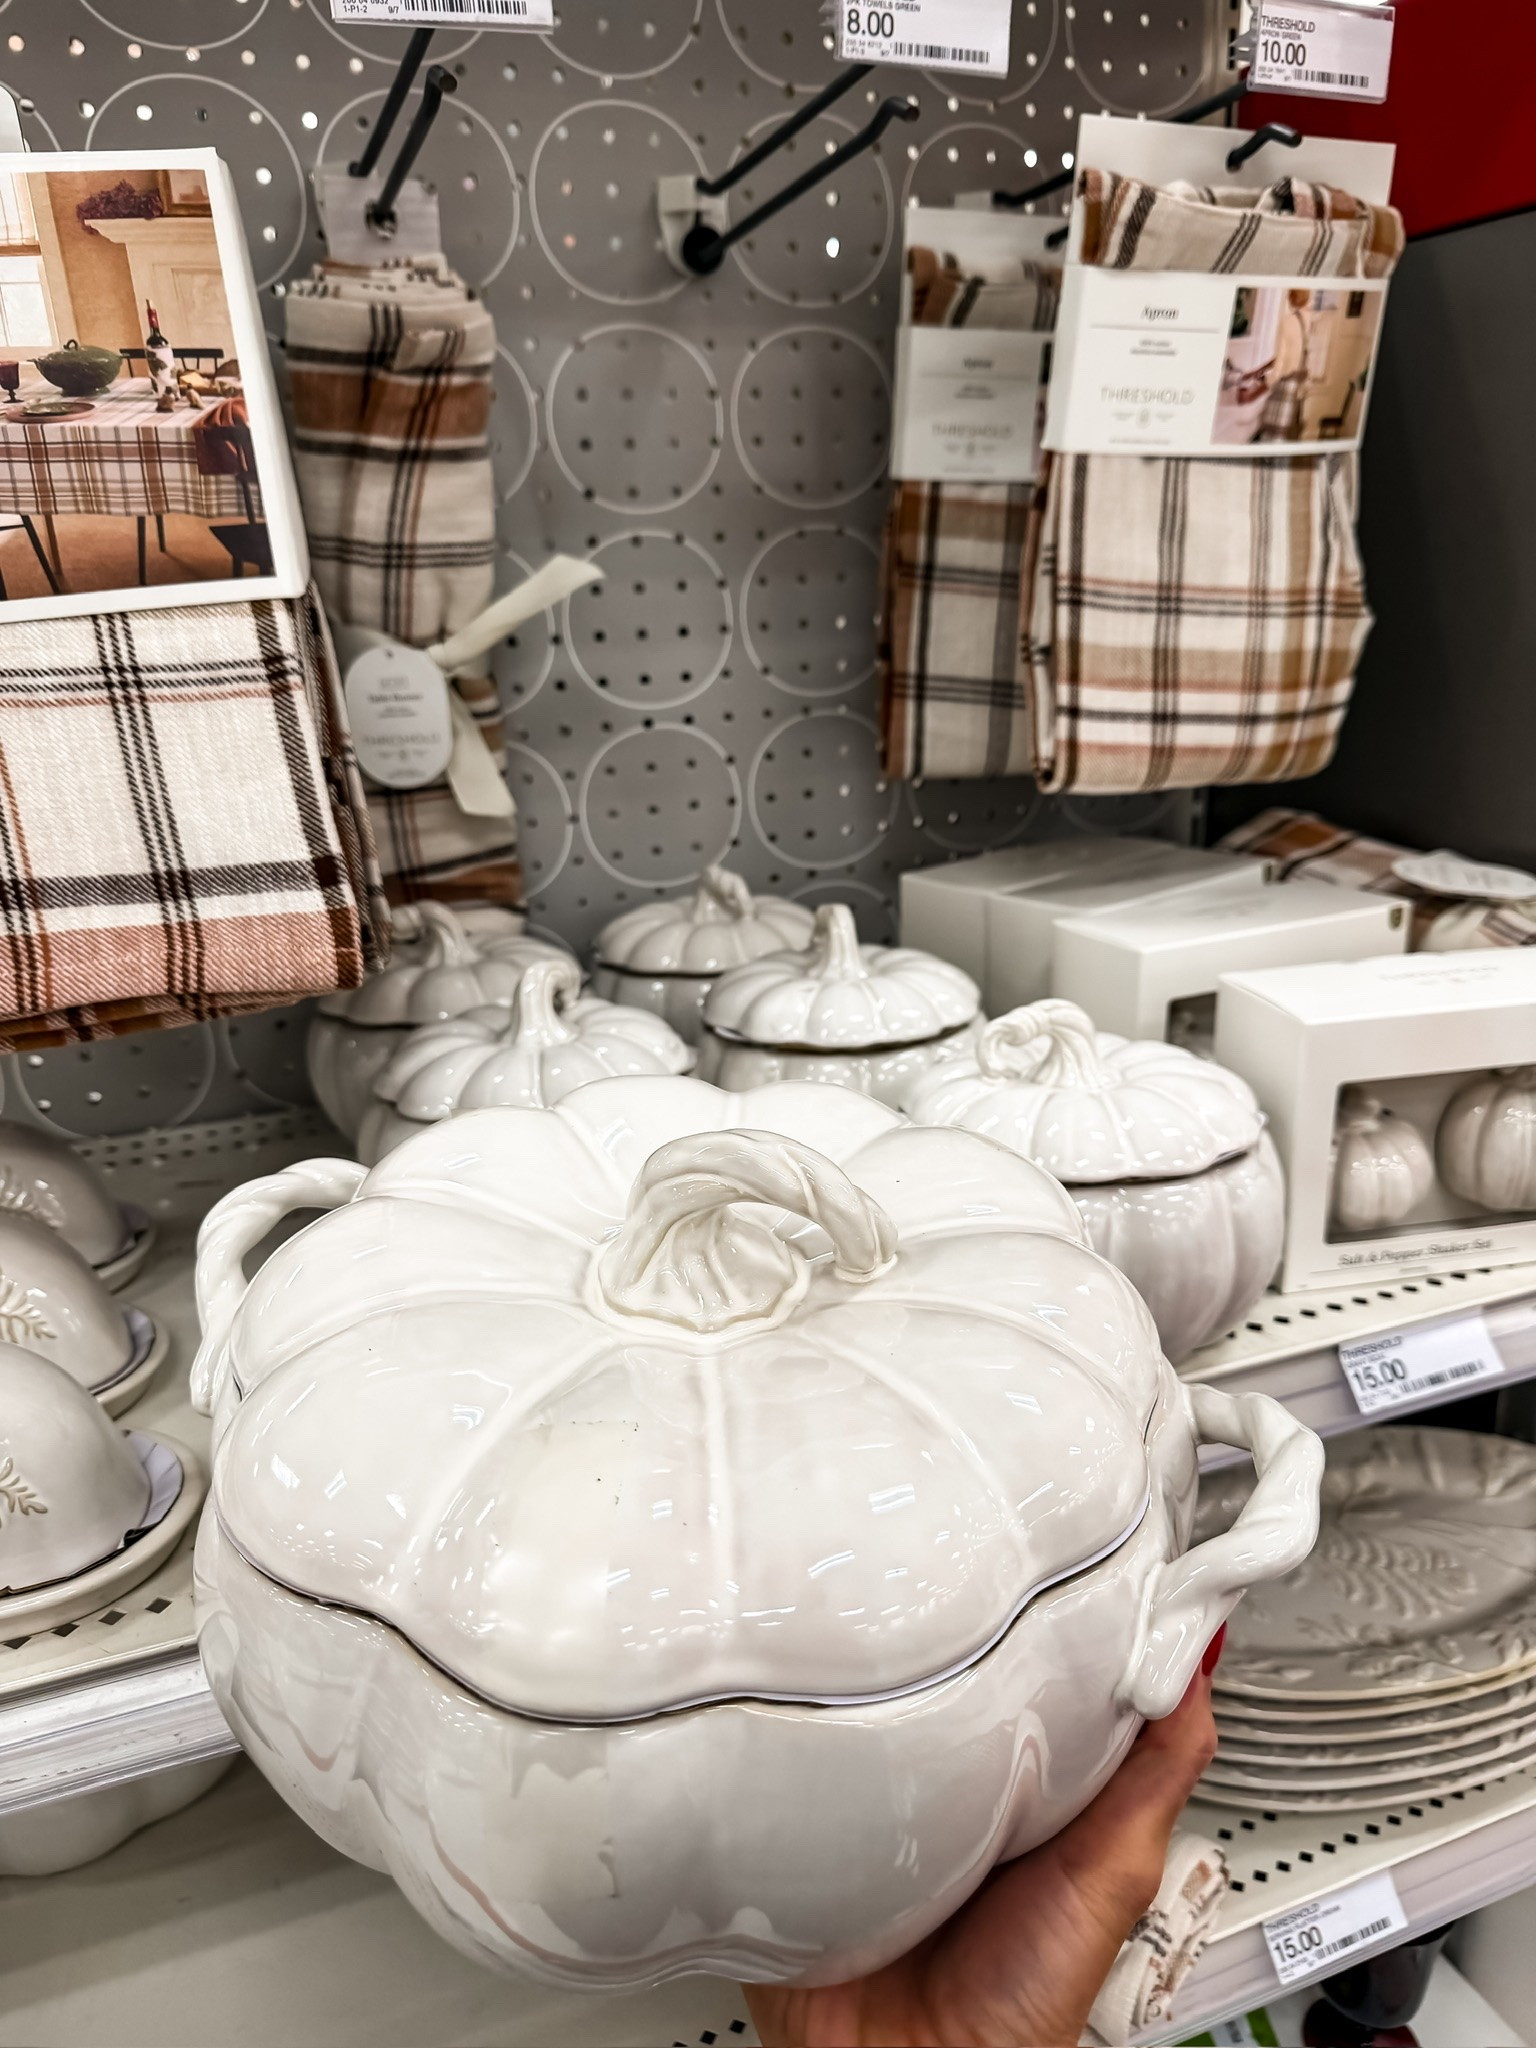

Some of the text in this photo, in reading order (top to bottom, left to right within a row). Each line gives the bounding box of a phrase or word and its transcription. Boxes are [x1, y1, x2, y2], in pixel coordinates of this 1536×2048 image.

[343, 5, 368, 13] 1-P1-2
[894, 2, 921, 12] GREEN
[847, 9, 894, 38] 8.00
[1261, 15, 1316, 33] THRESHOLD
[1261, 40, 1306, 66] 10.00
[1142, 305, 1178, 321] Apron
[1101, 387, 1195, 405] THRESHOLD
[1353, 1358, 1407, 1391] 15.00
[1273, 1926, 1322, 1963] 15.00
